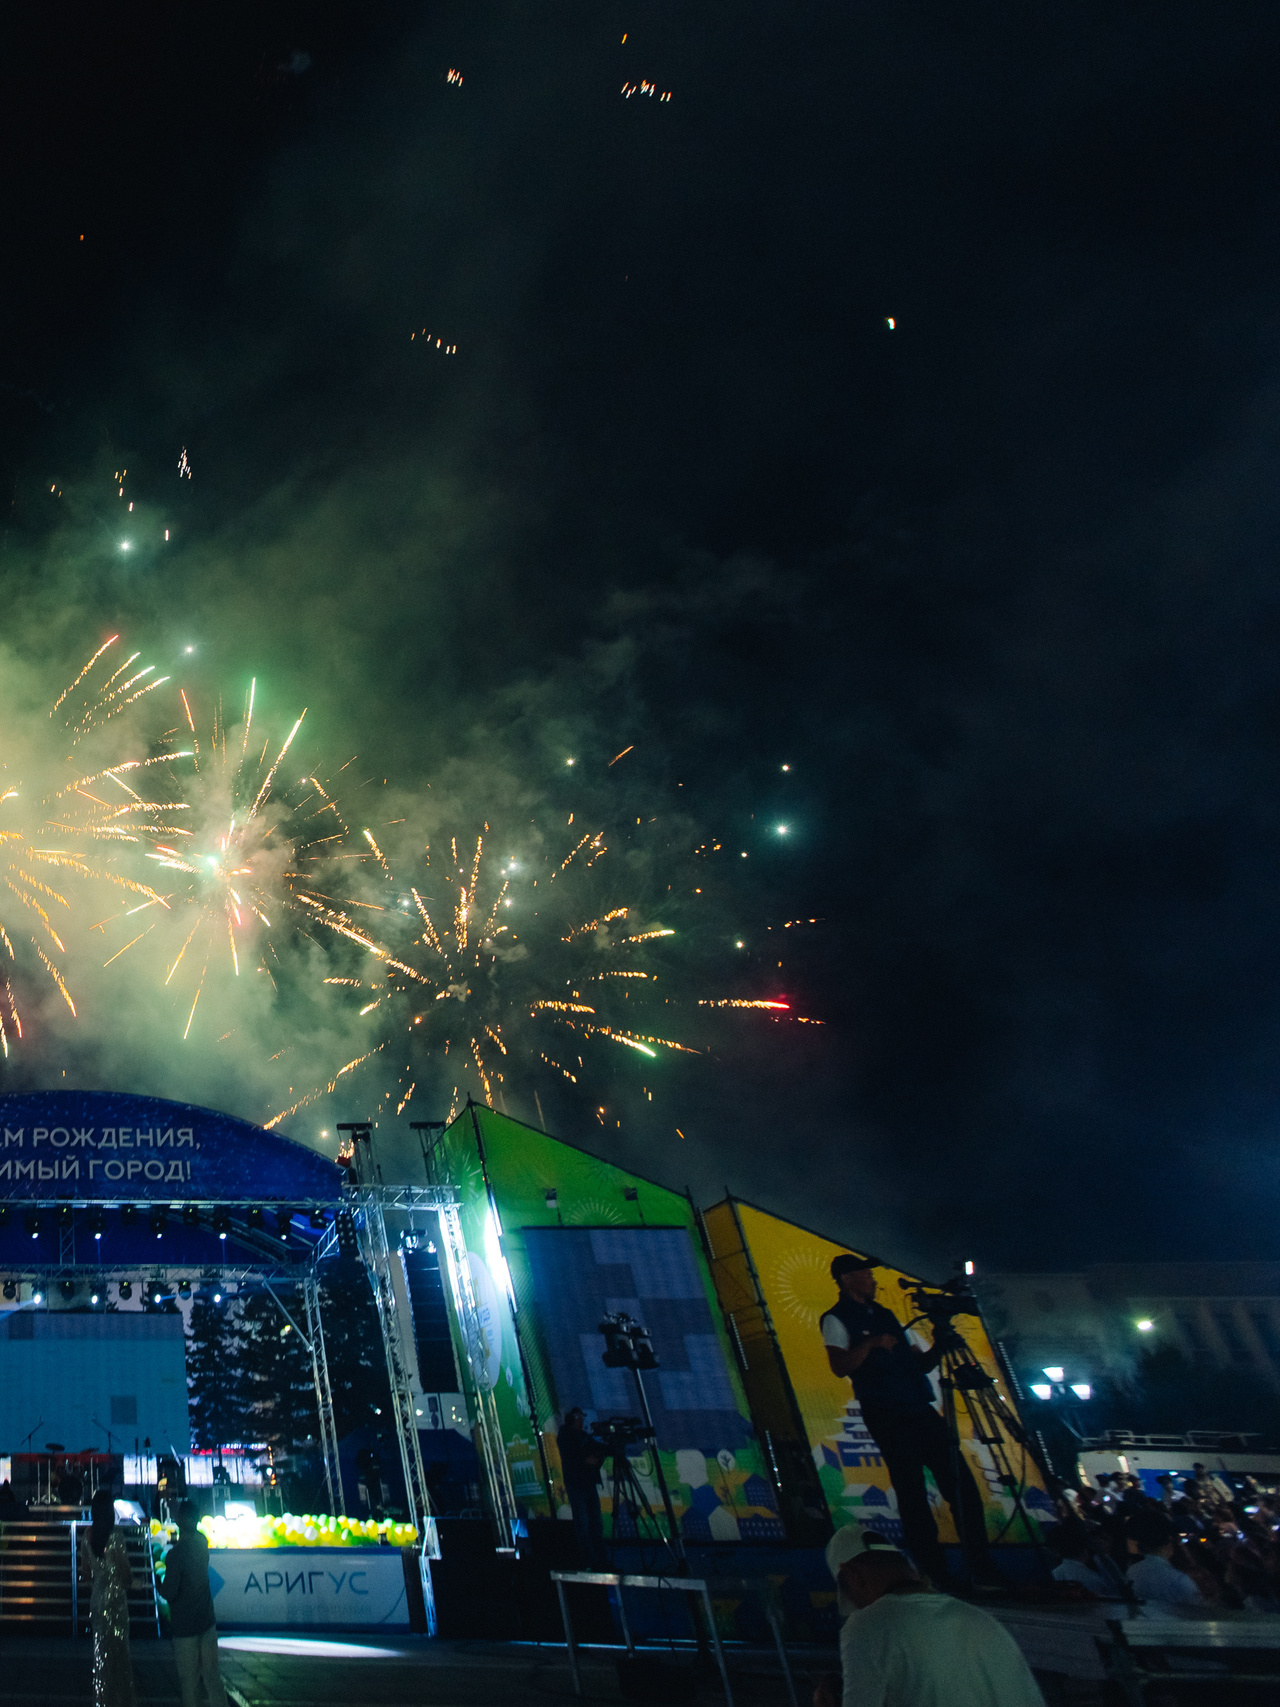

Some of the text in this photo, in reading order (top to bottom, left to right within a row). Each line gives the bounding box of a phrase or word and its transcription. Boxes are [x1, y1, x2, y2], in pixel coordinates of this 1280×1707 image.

[33, 1126, 201, 1151] РОЖДЕНИЯ,
[88, 1159, 192, 1183] ГОРОД!
[243, 1571, 370, 1595] АРИГУС
